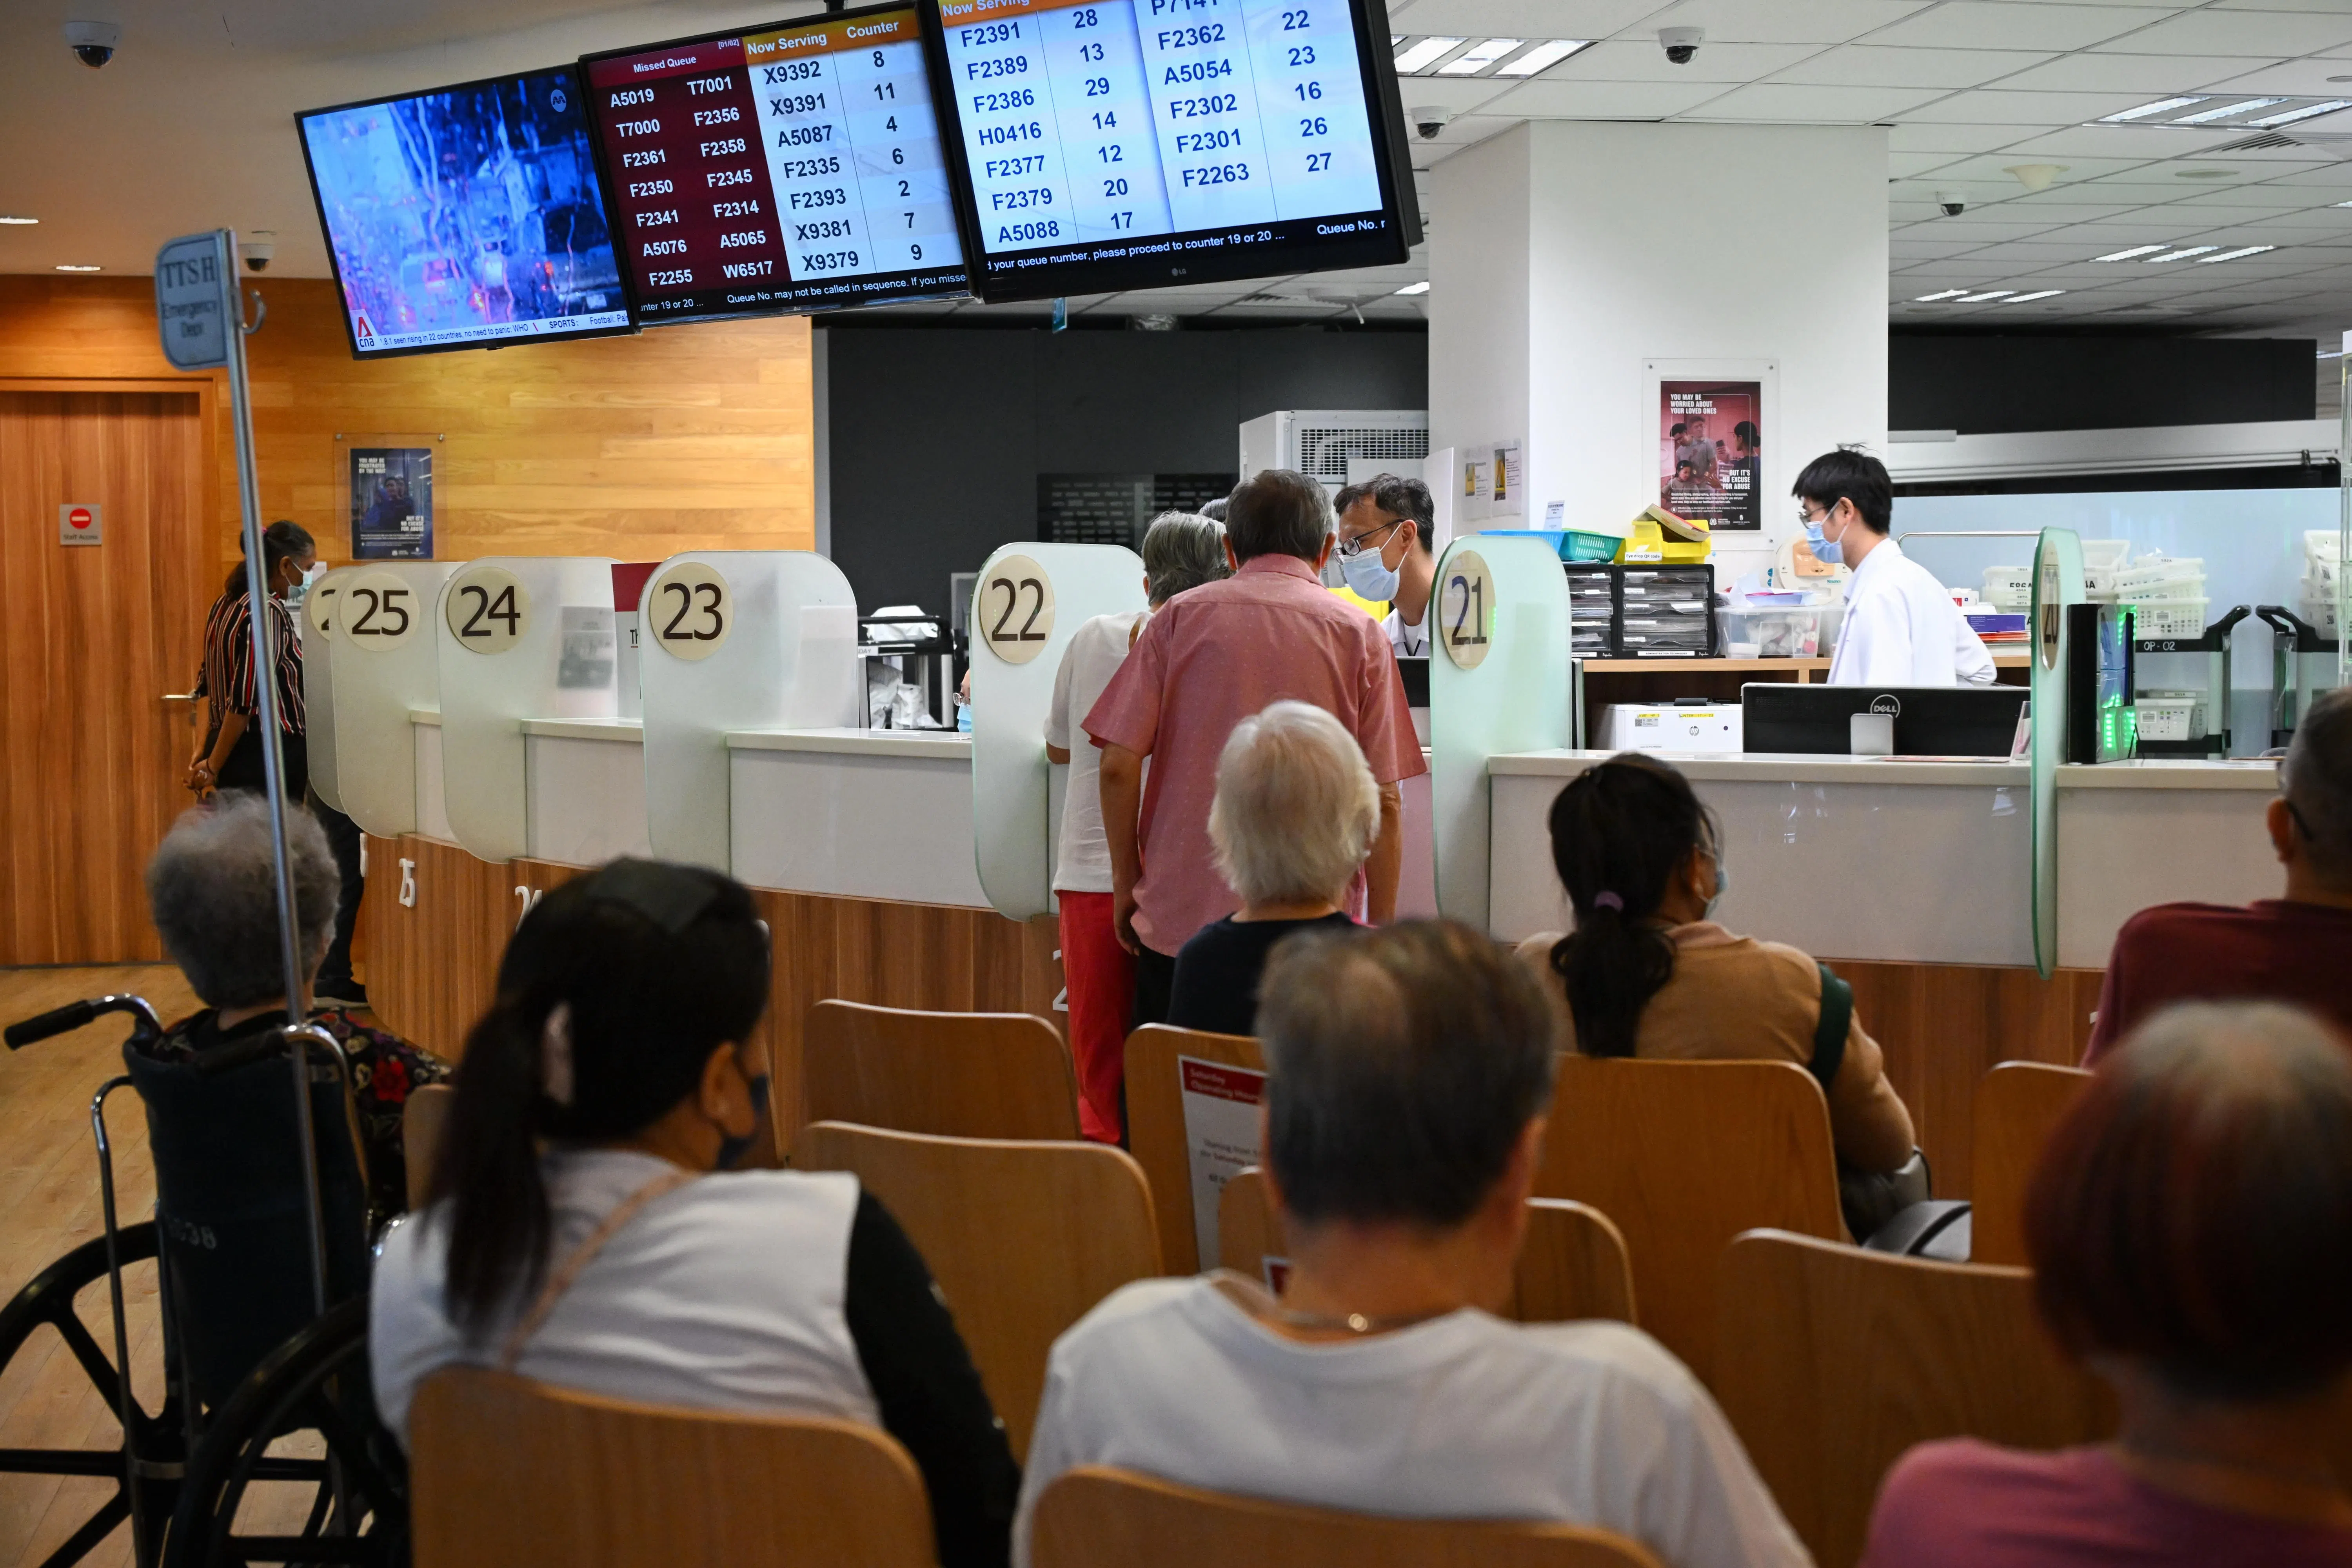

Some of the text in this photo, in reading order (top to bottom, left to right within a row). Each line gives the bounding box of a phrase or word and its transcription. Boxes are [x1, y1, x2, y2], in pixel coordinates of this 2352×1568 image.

[943, 0, 1029, 17] Now Serving
[718, 39, 739, 49] [01/02]
[748, 20, 899, 55] Now Serving Counter
[961, 9, 1098, 47] F2391 28
[1158, 9, 1310, 50] F2362 22
[633, 56, 697, 73] Missed Queue
[764, 51, 885, 85] X9392 8
[967, 43, 1104, 80] F2389 13
[1164, 46, 1316, 85] A5054 23
[610, 76, 732, 108] A5019 T7001
[770, 82, 895, 116] X9391 11
[973, 77, 1110, 113] F2386 29
[1170, 82, 1322, 119] F2302 16
[616, 107, 740, 138] T7000 F2356
[778, 116, 898, 147] A5087 4
[978, 111, 1117, 146] H0416 14
[1176, 117, 1328, 153] F2301 26
[623, 138, 746, 168] F2361 F2358
[784, 148, 904, 179] F2335 6
[986, 144, 1123, 178] F2377 12
[630, 169, 753, 197] F2350 F2345
[1182, 153, 1332, 187] F2263 27
[790, 180, 910, 209] F2393 2
[992, 178, 1128, 211] F2379 20
[636, 200, 759, 227] F2341 F2314
[795, 212, 915, 241] X9381 7
[998, 211, 1133, 243] A5088 17
[1317, 223, 1355, 235] Queue
[1358, 220, 1378, 230] No.
[643, 231, 766, 257] A5076 A5065
[802, 244, 922, 271] X9379 9
[994, 260, 1015, 271] your
[1017, 257, 1048, 269] queue
[1050, 251, 1091, 263] number,
[1093, 248, 1126, 261] please
[1129, 241, 1170, 257] proceed
[1172, 241, 1183, 250] to
[1185, 237, 1224, 249] counter
[1227, 234, 1241, 245] 19
[1244, 234, 1255, 243] or
[1257, 230, 1272, 241] 20
[161, 256, 216, 289] TTSH
[648, 261, 773, 286] F2255 W6517
[661, 301, 671, 309] 19
[684, 298, 694, 307] 20
[727, 294, 756, 304] Queue
[757, 292, 773, 301] No.
[775, 290, 792, 300] may
[795, 287, 809, 297] not
[810, 286, 822, 295] be
[824, 283, 850, 294] called
[851, 282, 861, 292] in
[862, 279, 909, 294] sequence.
[911, 277, 918, 286] If
[919, 276, 936, 287] you
[408, 336, 422, 344] rising
[437, 330, 464, 340] countries,
[473, 328, 487, 336] need
[495, 327, 512, 336] panic:
[512, 323, 529, 332] WHO
[589, 316, 616, 325] Football:
[359, 338, 375, 348] cna
[351, 588, 409, 636] 25
[460, 585, 521, 637] 24
[663, 582, 723, 641] 23
[992, 578, 1046, 642] 22
[1451, 576, 1487, 646] 21
[1690, 726, 1699, 736] hp
